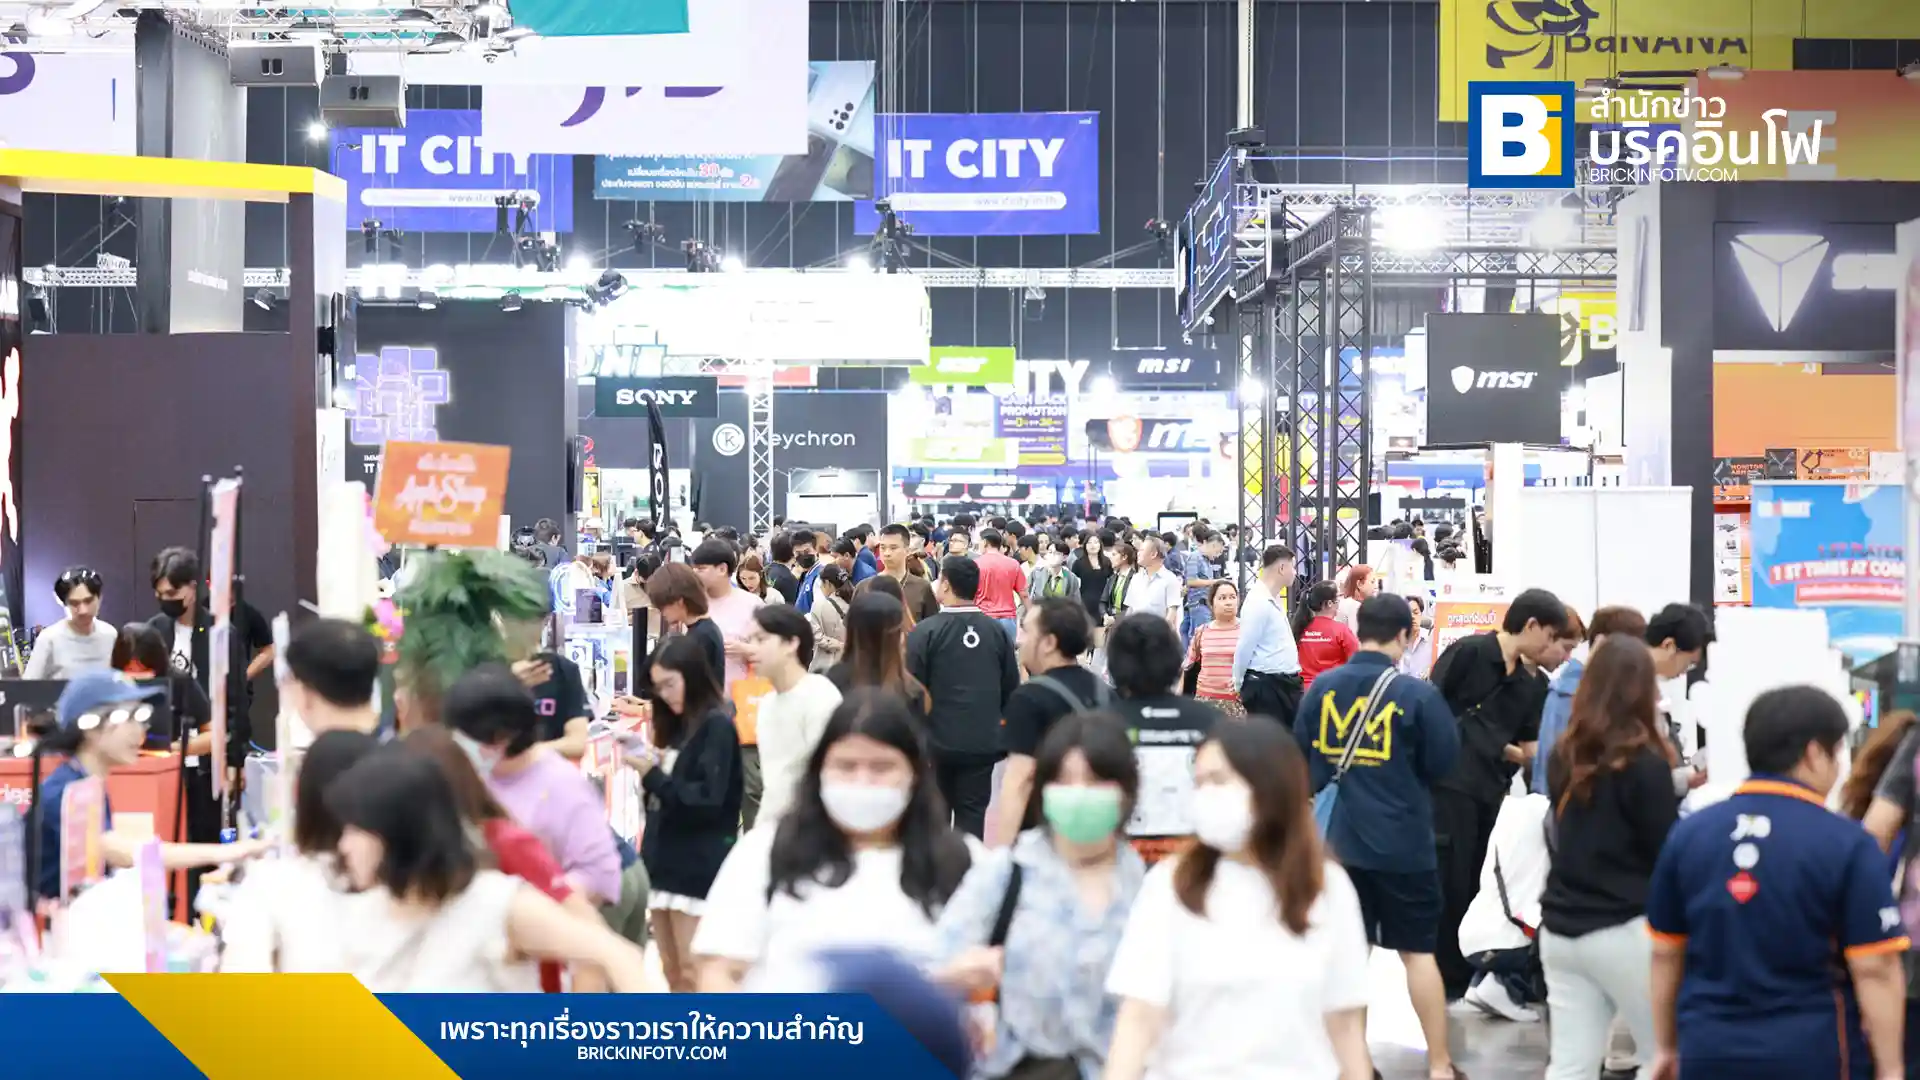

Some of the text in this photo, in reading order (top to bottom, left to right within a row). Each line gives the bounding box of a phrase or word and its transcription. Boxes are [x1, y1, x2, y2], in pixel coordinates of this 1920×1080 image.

[362, 134, 406, 174] IT
[887, 137, 1064, 178] IT CITY
[1137, 358, 1192, 373] msi
[1477, 369, 1533, 389] msi
[616, 388, 697, 406] SONY
[754, 430, 856, 450] Keychron
